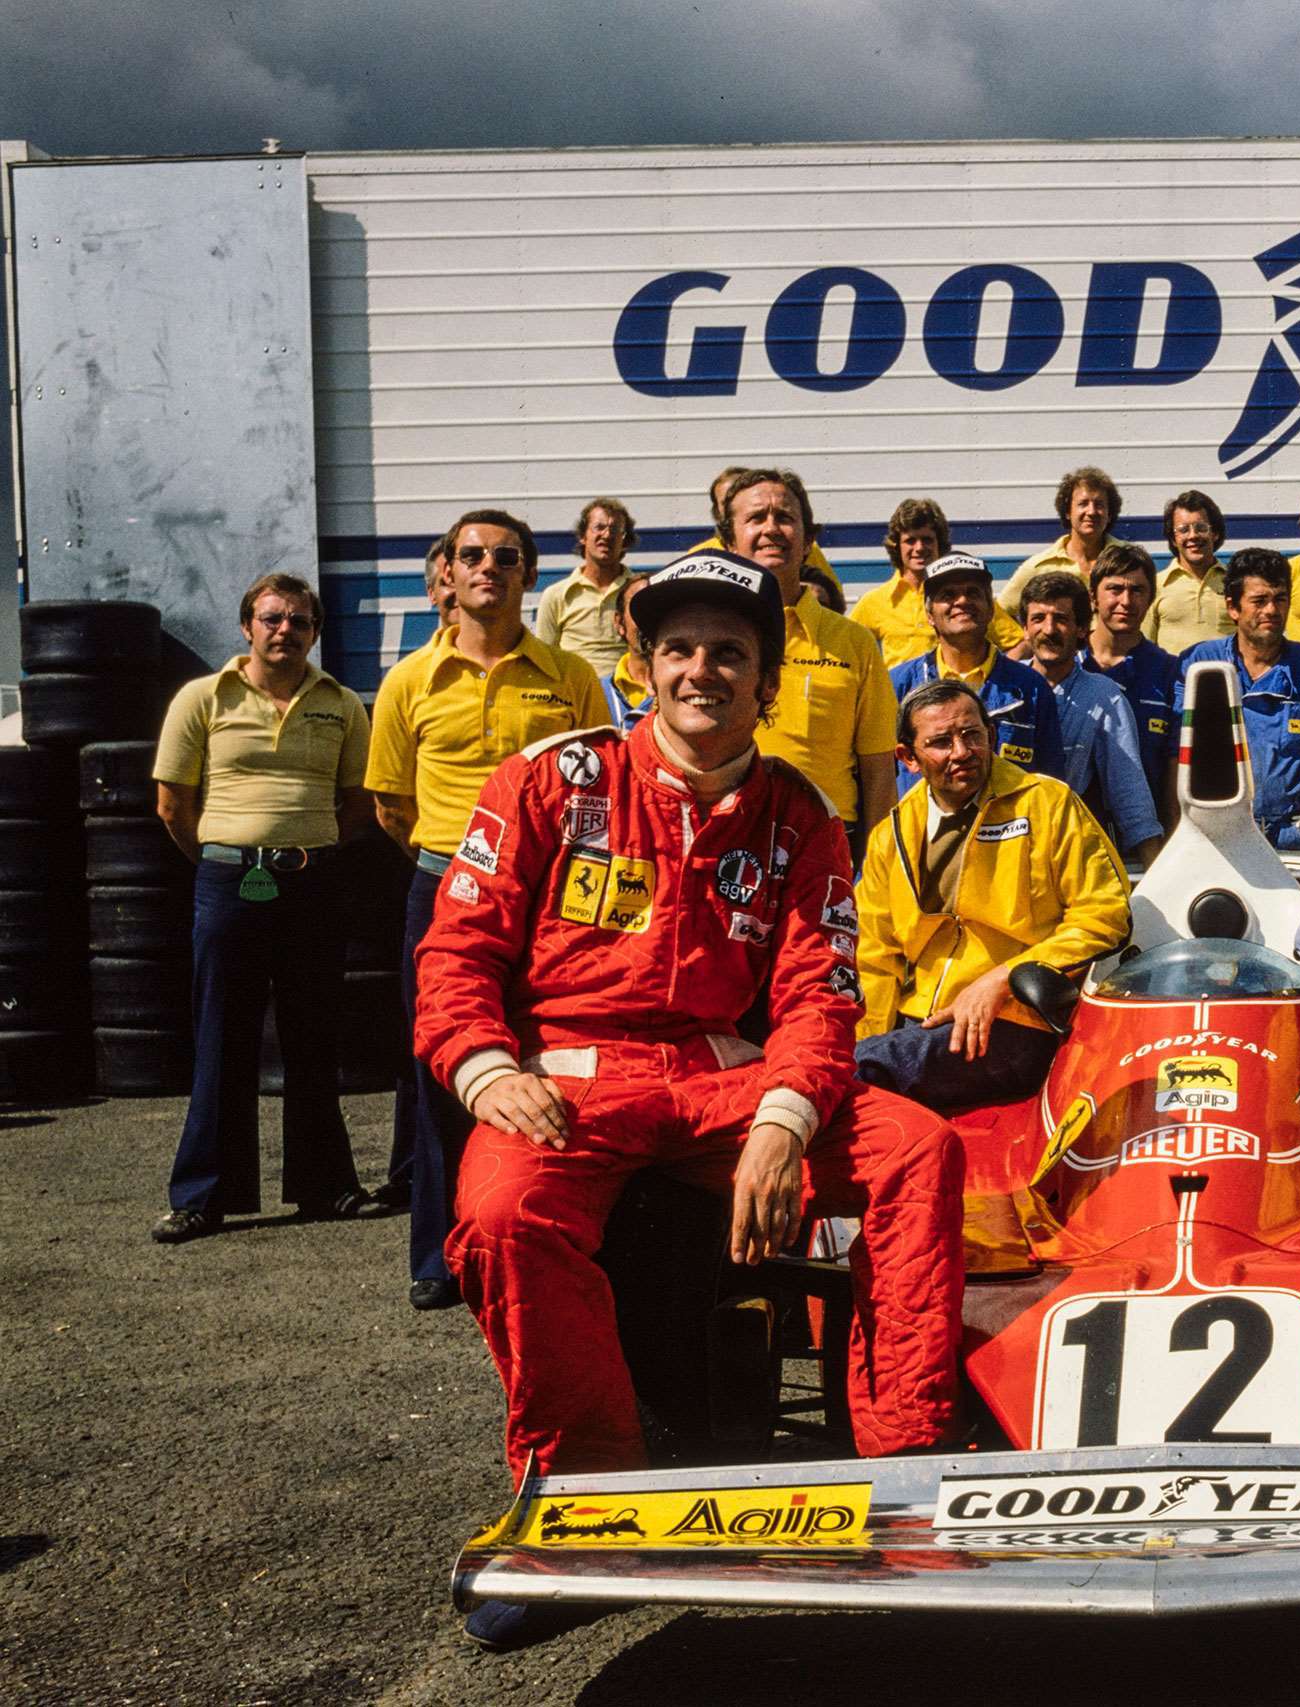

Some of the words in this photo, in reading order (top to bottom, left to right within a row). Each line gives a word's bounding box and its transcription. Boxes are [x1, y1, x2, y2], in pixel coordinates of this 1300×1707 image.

[613, 262, 1222, 397] GOOD
[706, 563, 753, 588] YEAR
[719, 880, 755, 904] agv
[607, 907, 646, 929] Agip
[1119, 1034, 1194, 1067] GOOD
[1211, 1034, 1279, 1063] YEAR
[1162, 1089, 1230, 1107] Agip
[1130, 1126, 1250, 1158] HEUER
[1061, 1294, 1275, 1448] 12
[662, 1493, 857, 1538] Agip
[946, 1485, 1147, 1520] GOOD
